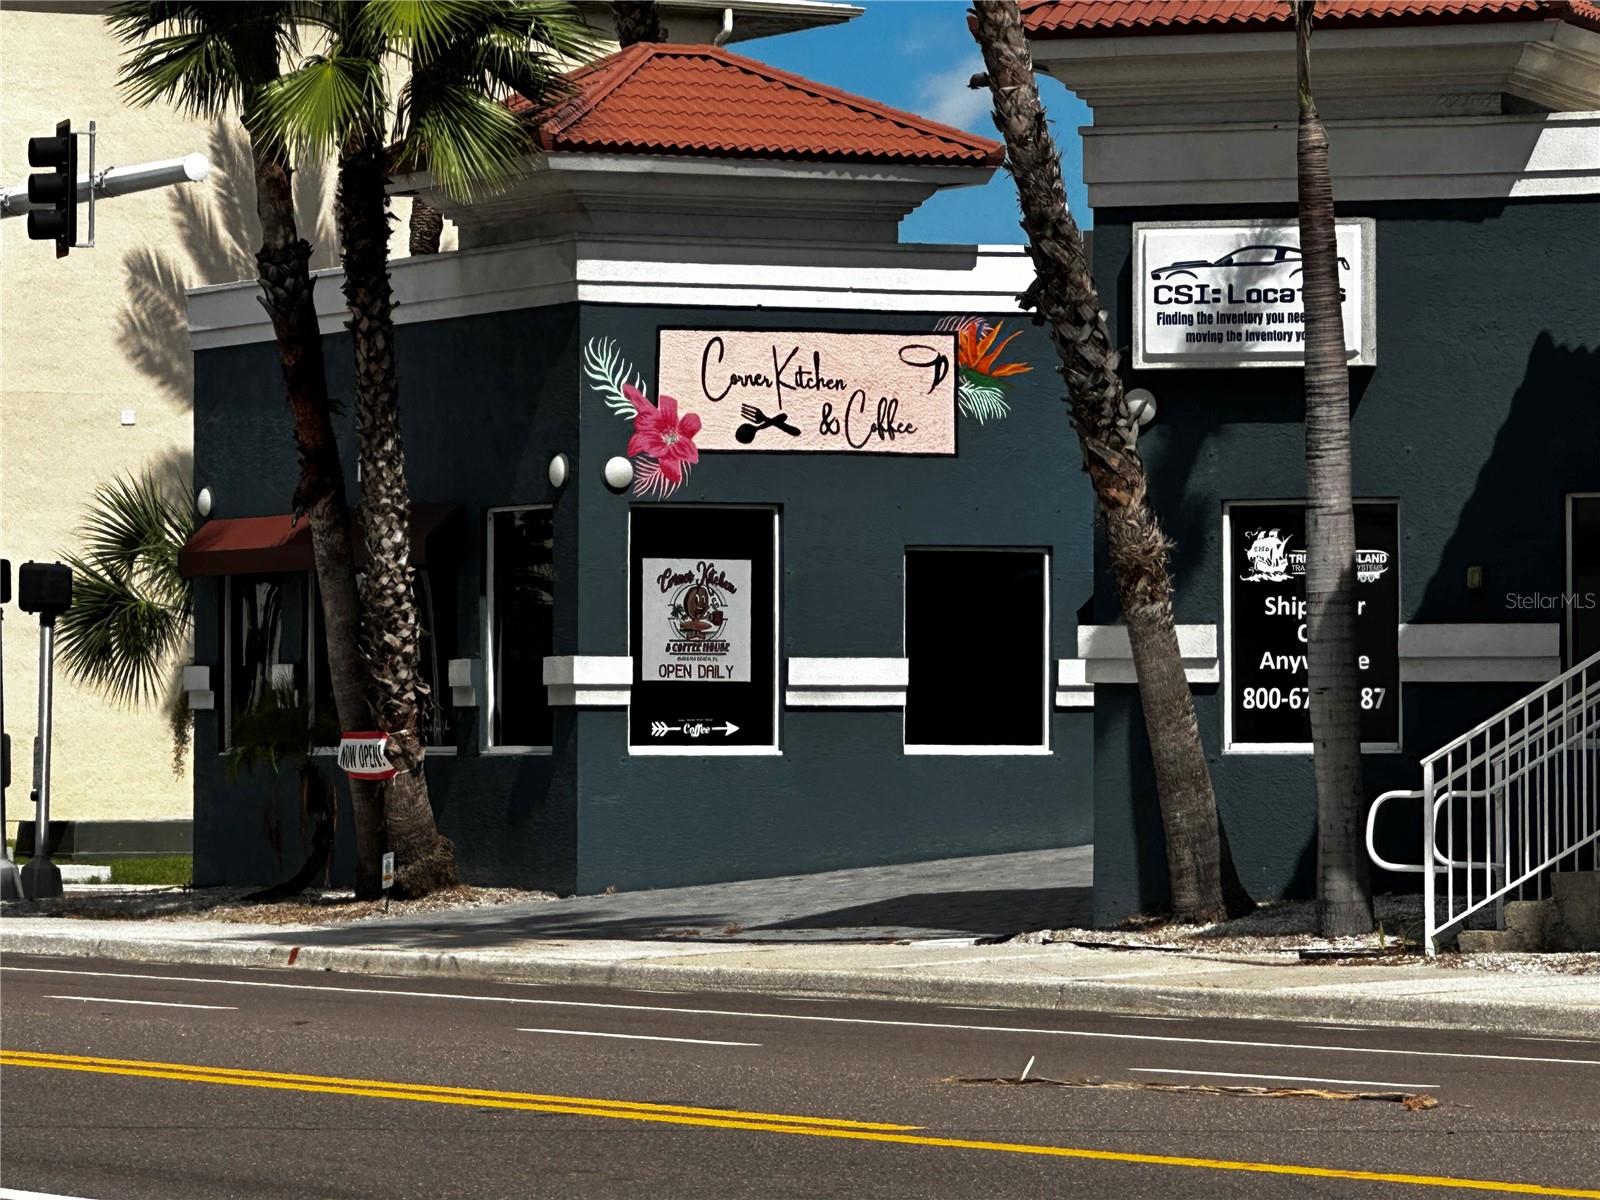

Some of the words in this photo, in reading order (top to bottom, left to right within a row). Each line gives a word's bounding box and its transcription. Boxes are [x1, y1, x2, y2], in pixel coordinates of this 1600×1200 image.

[1153, 284, 1221, 305] CSI:
[1156, 311, 1194, 326] Finding
[1196, 311, 1213, 325] the
[1266, 312, 1285, 325] you
[1287, 312, 1305, 324] nee
[1185, 330, 1224, 343] moving
[1226, 330, 1243, 342] the
[701, 336, 773, 402] Corner
[772, 345, 847, 410] Kitchen
[819, 402, 841, 436] &
[844, 389, 918, 449] Coffee
[1355, 554, 1387, 564] LAND
[658, 664, 692, 679] OPEN
[697, 664, 734, 679] DAILY
[683, 723, 711, 738] Coffee
[340, 744, 357, 769] NOW
[358, 744, 386, 768] OPEN!
